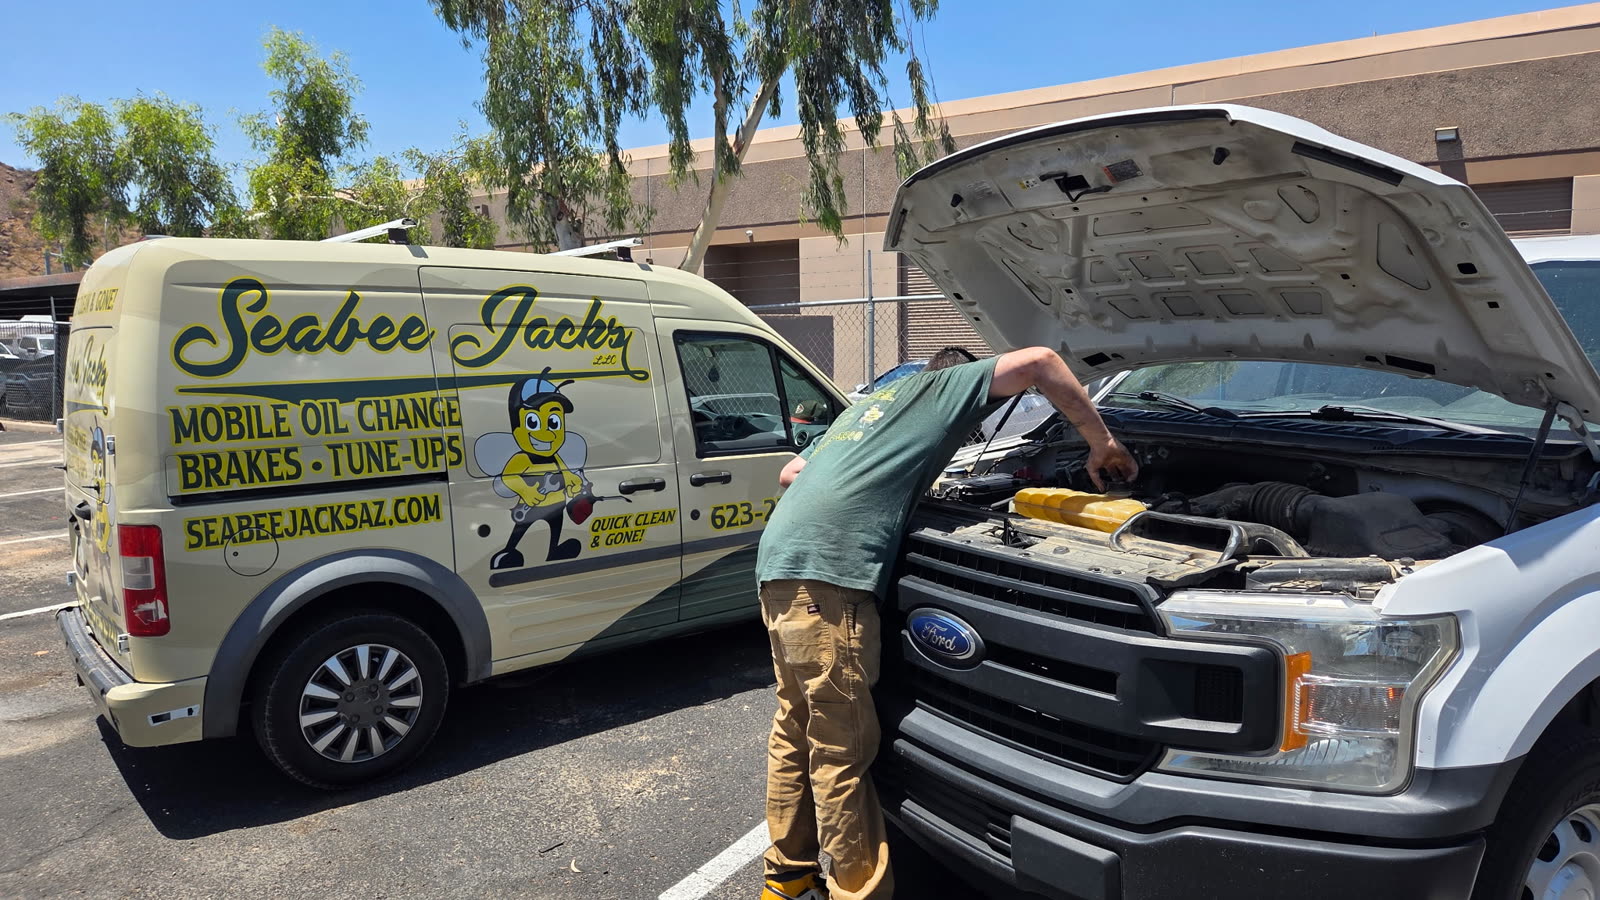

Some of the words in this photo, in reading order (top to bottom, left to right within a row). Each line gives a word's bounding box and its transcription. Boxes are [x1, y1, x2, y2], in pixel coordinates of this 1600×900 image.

[174, 278, 436, 378] Seabee
[451, 285, 634, 370] Jacks
[592, 354, 617, 366] LLC
[169, 403, 292, 445] MOBILE
[301, 400, 349, 436] OIL
[358, 396, 463, 432] CHANGE
[178, 446, 302, 490] BRAKES
[326, 435, 463, 477] TUNE-UPS
[186, 494, 441, 550] SEABEEJACKSAZ.COM
[591, 514, 633, 533] QUICK
[634, 509, 676, 528] CLEAN
[710, 496, 782, 530] 623-2
[590, 535, 601, 549] &
[605, 529, 646, 547] GONE!
[921, 621, 957, 651] Ford
